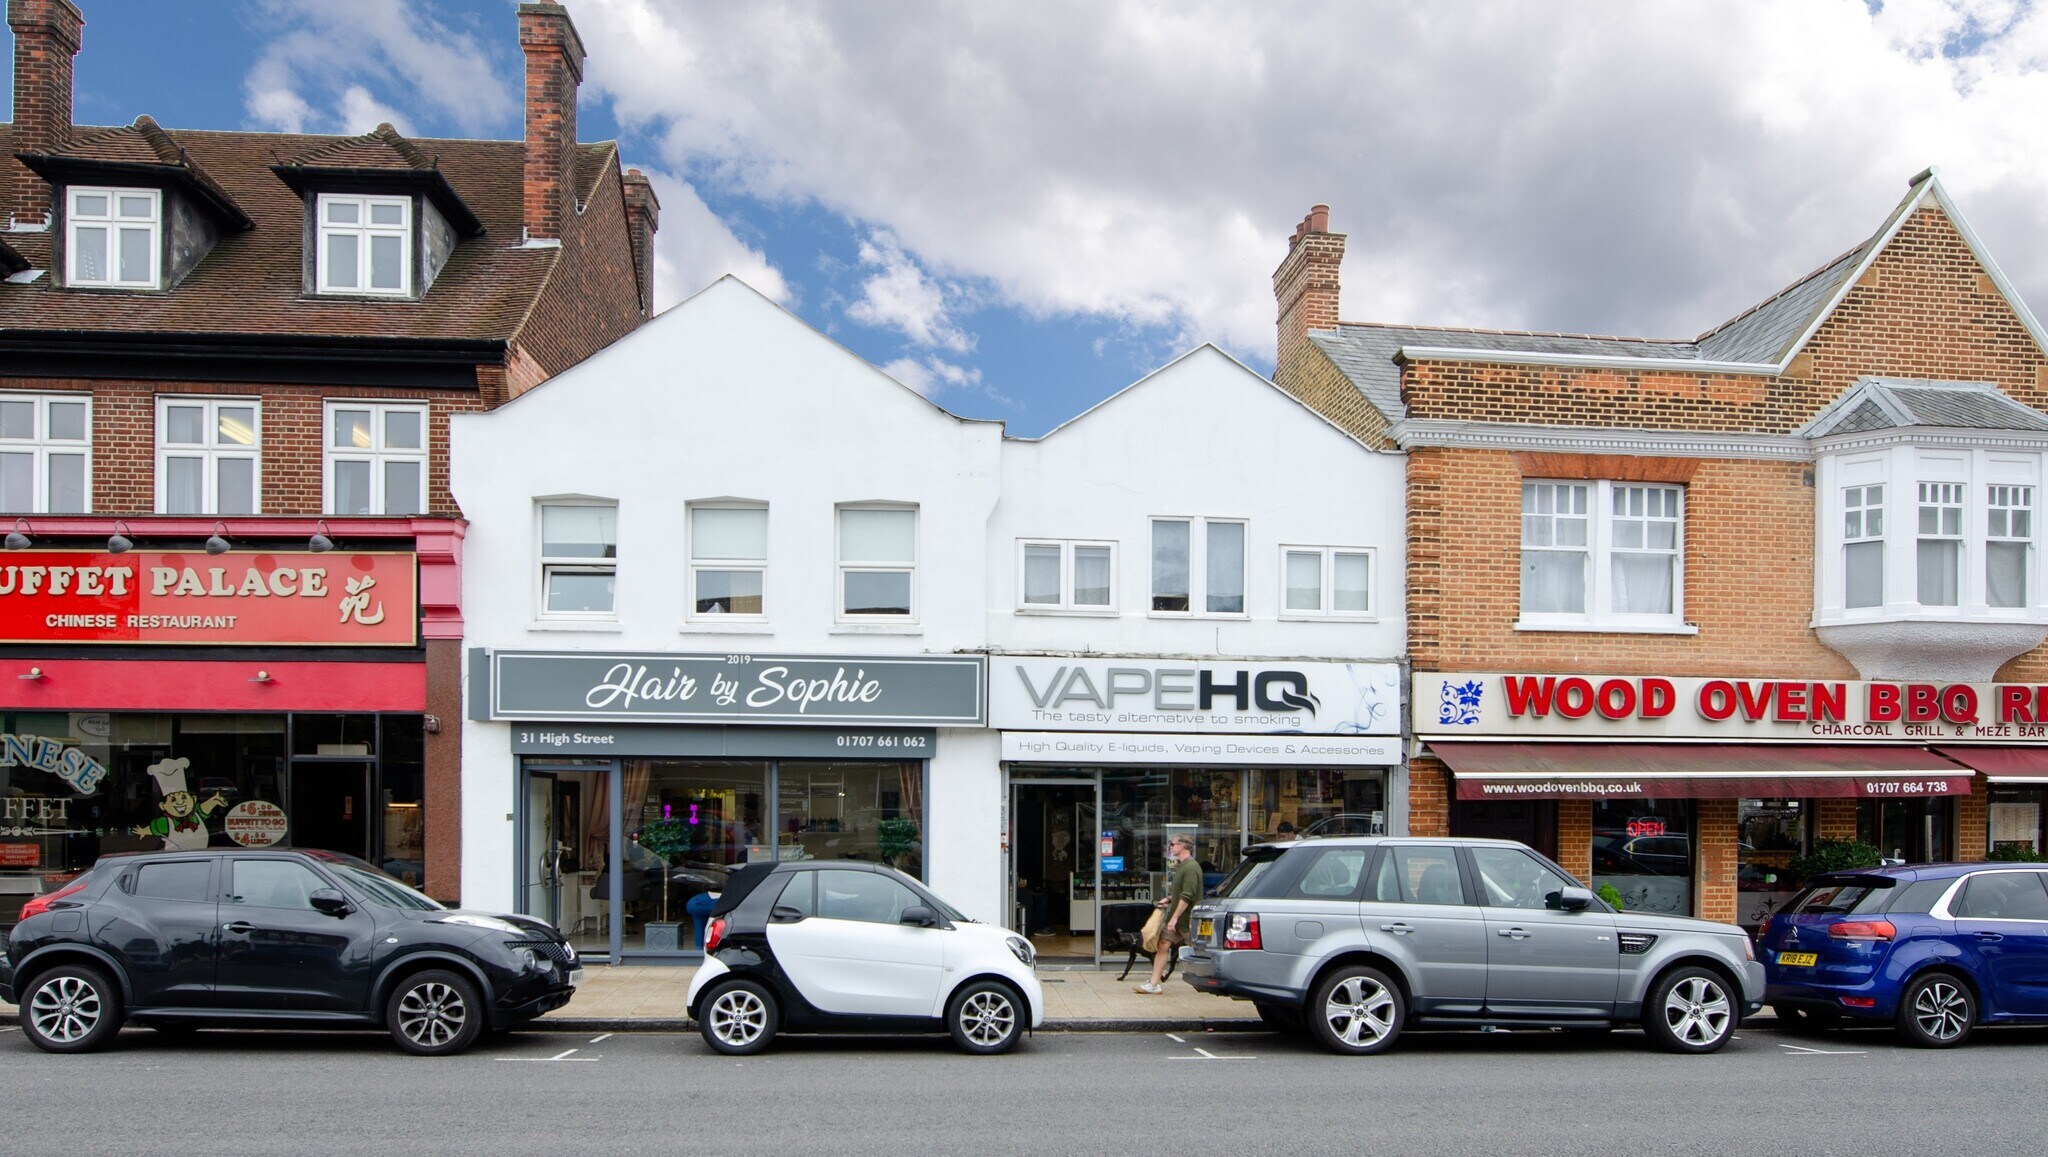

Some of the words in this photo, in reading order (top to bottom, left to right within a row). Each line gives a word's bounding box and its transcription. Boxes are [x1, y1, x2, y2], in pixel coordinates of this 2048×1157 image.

[150, 567, 328, 597] PALACE
[46, 614, 117, 628] CHINESE
[127, 615, 237, 629] RESTAURANT
[727, 655, 751, 664] 2019
[586, 663, 698, 709] Hair
[710, 672, 739, 706] by
[746, 666, 882, 714] Sophie
[1501, 676, 1676, 720] WOOD
[1694, 680, 1847, 723] OVEN
[1865, 684, 1979, 726] BBQ
[1032, 710, 1062, 721] The
[1069, 712, 1112, 724] tasty
[1118, 712, 1204, 724] alternative
[1211, 715, 1228, 724] to
[1234, 714, 1300, 726] smoking
[1812, 724, 1892, 736] CHARCOAL
[1904, 726, 1944, 736] GRILL
[1955, 726, 1964, 737] &
[1975, 726, 2011, 737] MEZE
[2018, 727, 2046, 737] BAR
[521, 733, 534, 743] 31
[540, 733, 570, 746] High
[573, 733, 614, 744] Street
[836, 736, 874, 746] 01707
[877, 736, 898, 747] 661
[903, 736, 926, 747] 062
[1019, 742, 1050, 752] High
[1056, 742, 1103, 754] Quality
[1109, 742, 1168, 754] E-liquids,
[1175, 744, 1221, 755] Vaping
[1227, 744, 1279, 754] Devices
[1285, 745, 1295, 754] &
[1301, 745, 1384, 755] Accessories
[1483, 781, 1642, 794] www.woodovenbbq.co.uk
[1867, 783, 1899, 793] 01707
[1903, 782, 1923, 793] 664
[1926, 782, 1948, 793] 738
[1627, 822, 1664, 837] OPEN
